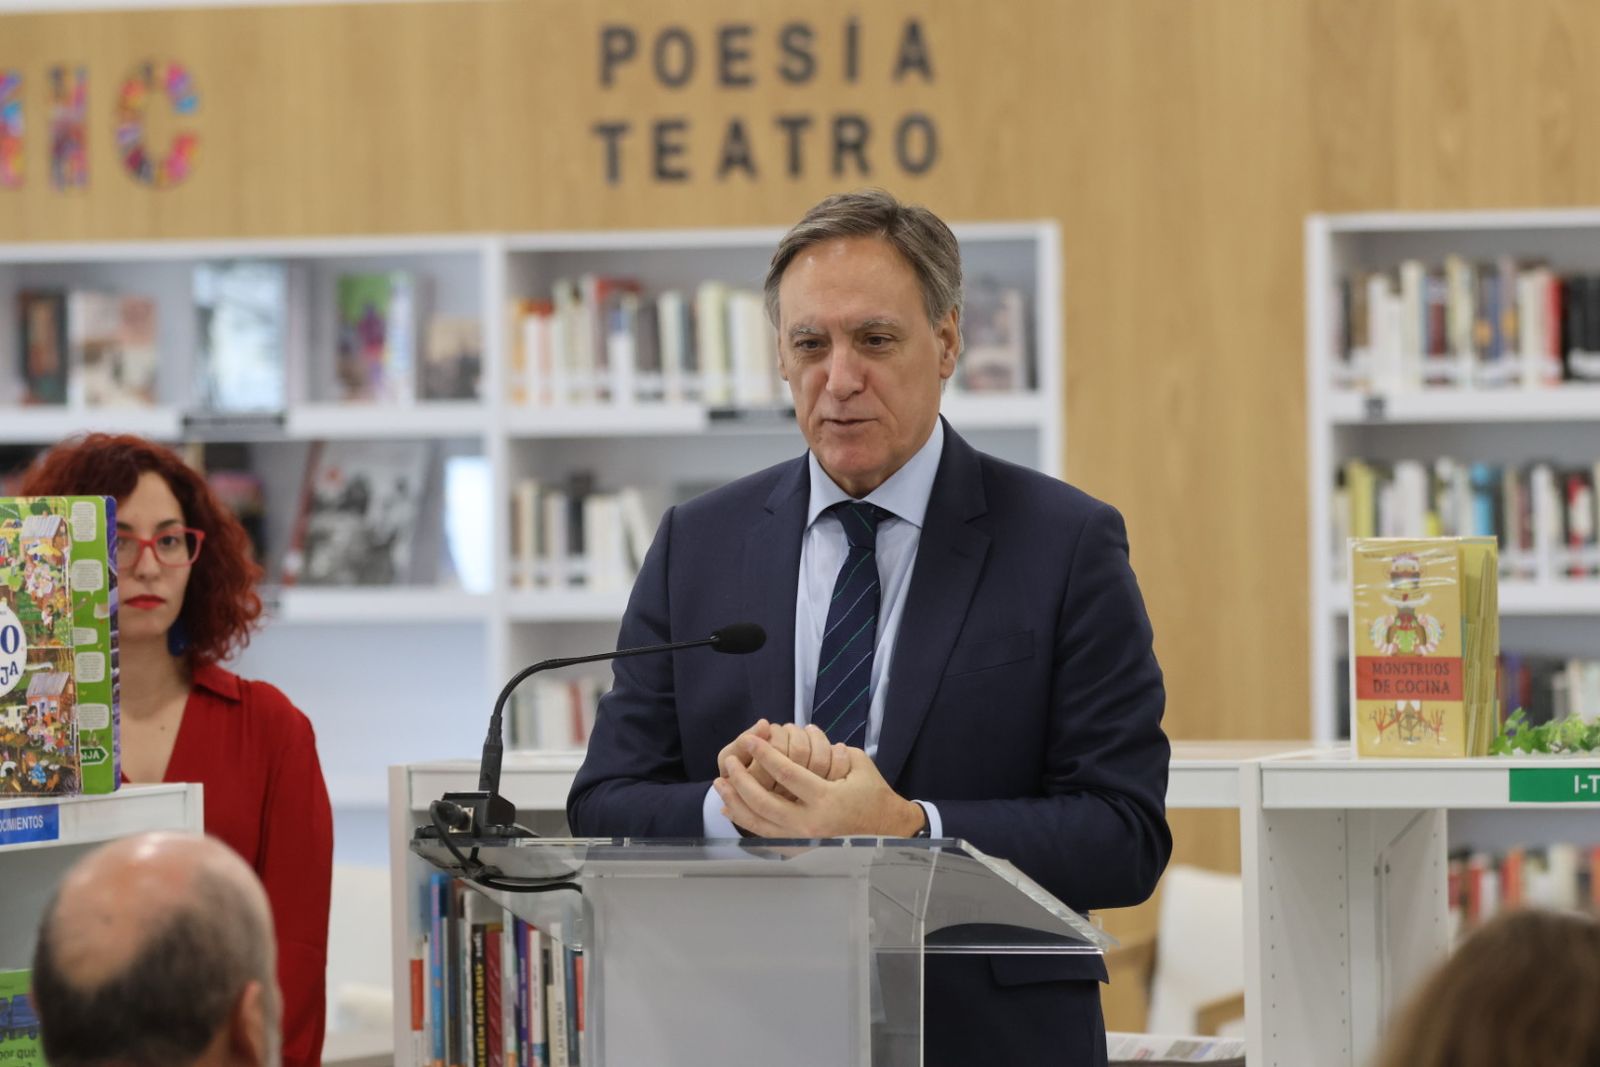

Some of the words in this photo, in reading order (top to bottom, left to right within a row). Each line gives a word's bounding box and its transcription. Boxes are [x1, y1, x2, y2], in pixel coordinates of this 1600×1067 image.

[592, 112, 939, 186] TEATRO
[1372, 662, 1450, 676] MONSTRUOS
[1373, 680, 1391, 693] DE
[1395, 680, 1450, 694] COCINA
